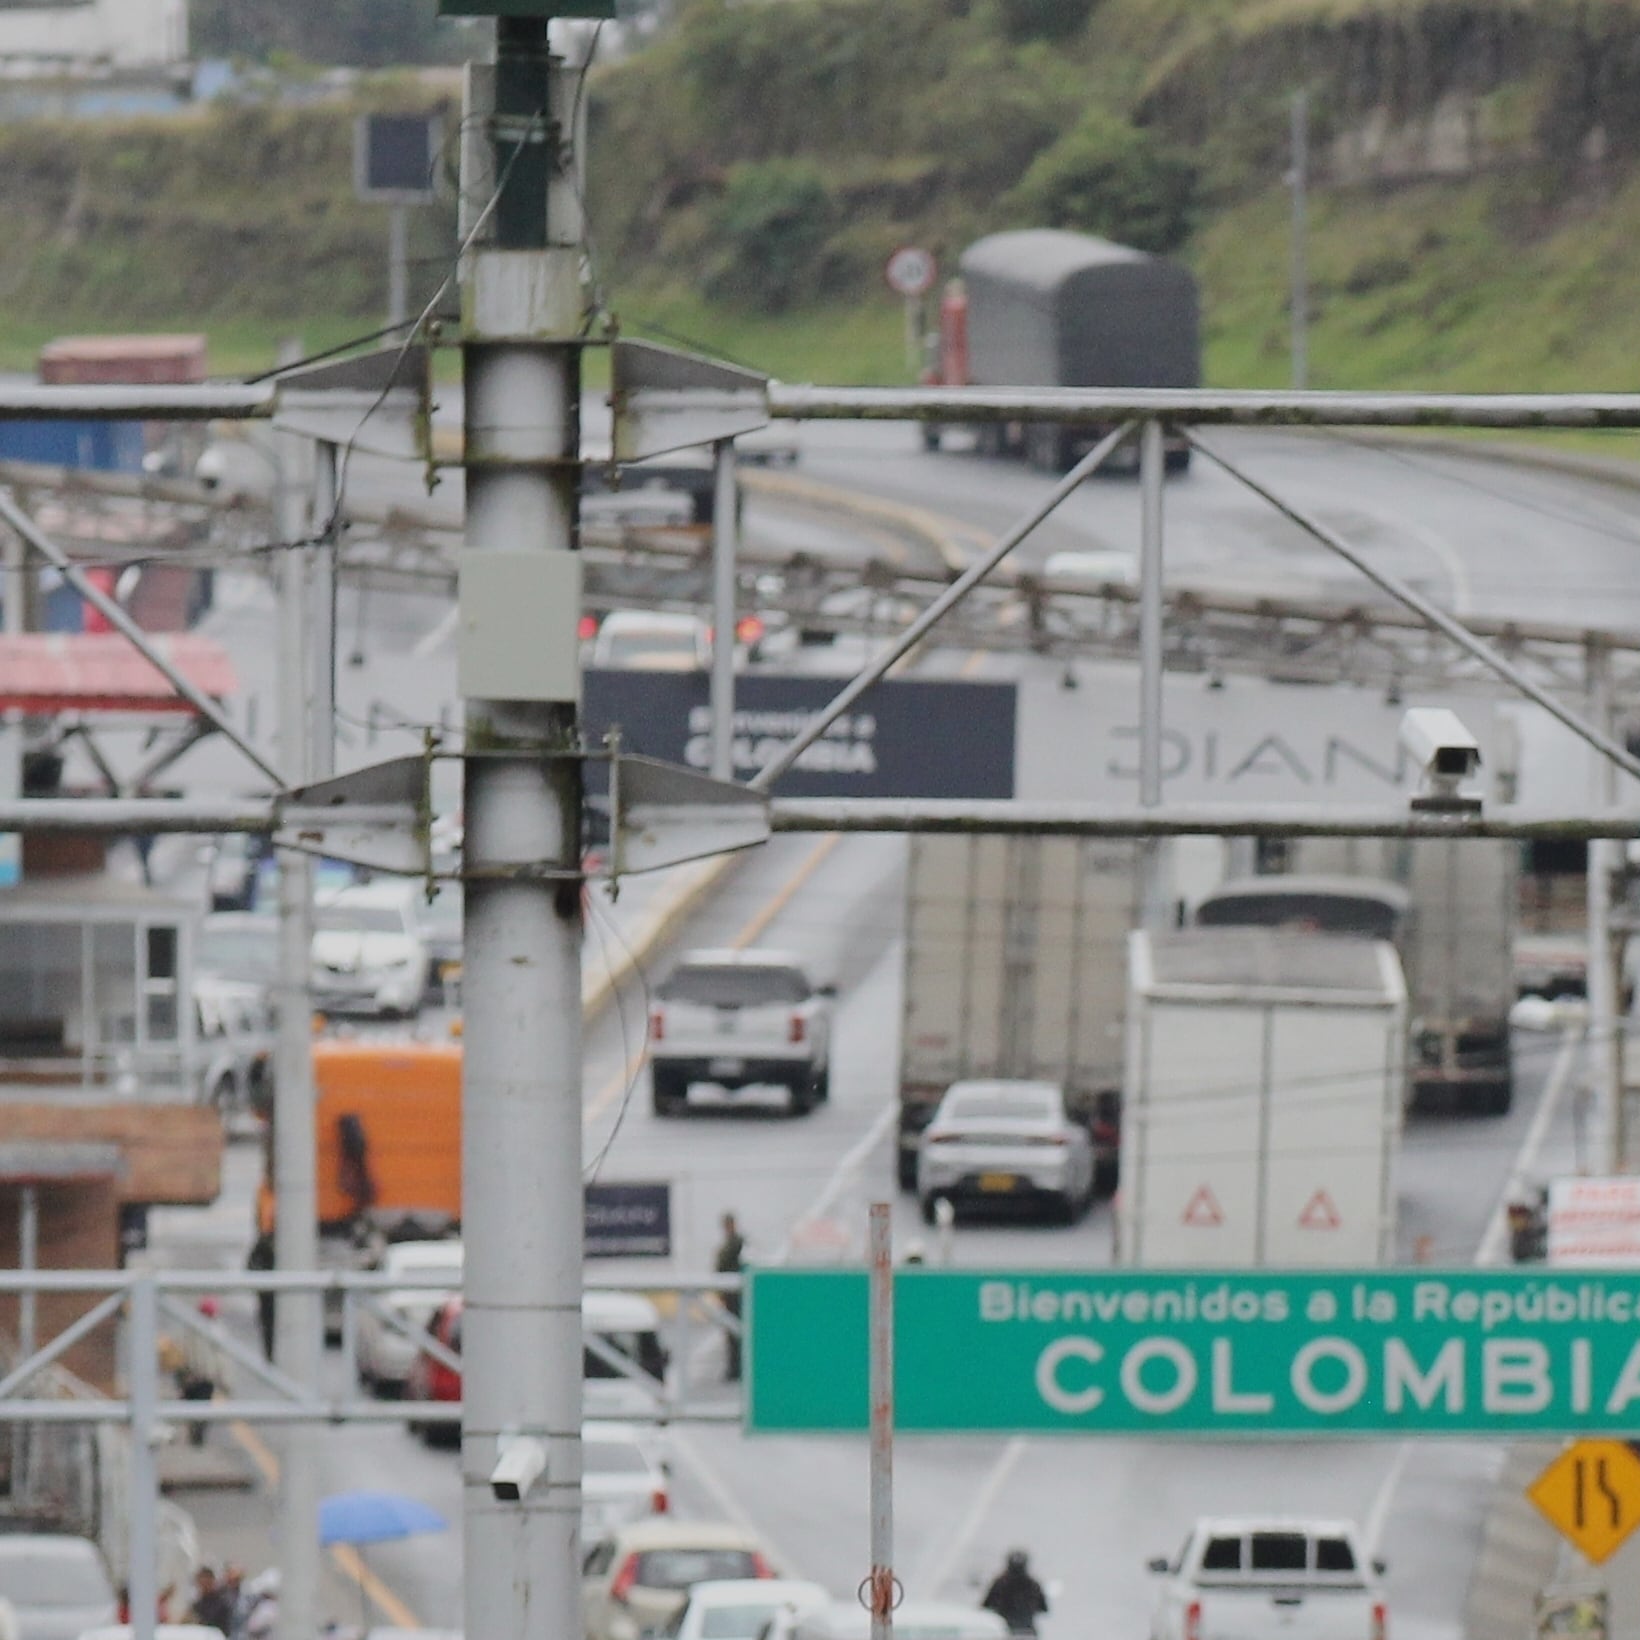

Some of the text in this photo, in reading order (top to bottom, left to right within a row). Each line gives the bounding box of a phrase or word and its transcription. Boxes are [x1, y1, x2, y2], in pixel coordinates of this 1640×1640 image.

[979, 1282, 1289, 1322] Bienvenidos
[1306, 1292, 1336, 1321] a
[1353, 1285, 1396, 1322] la
